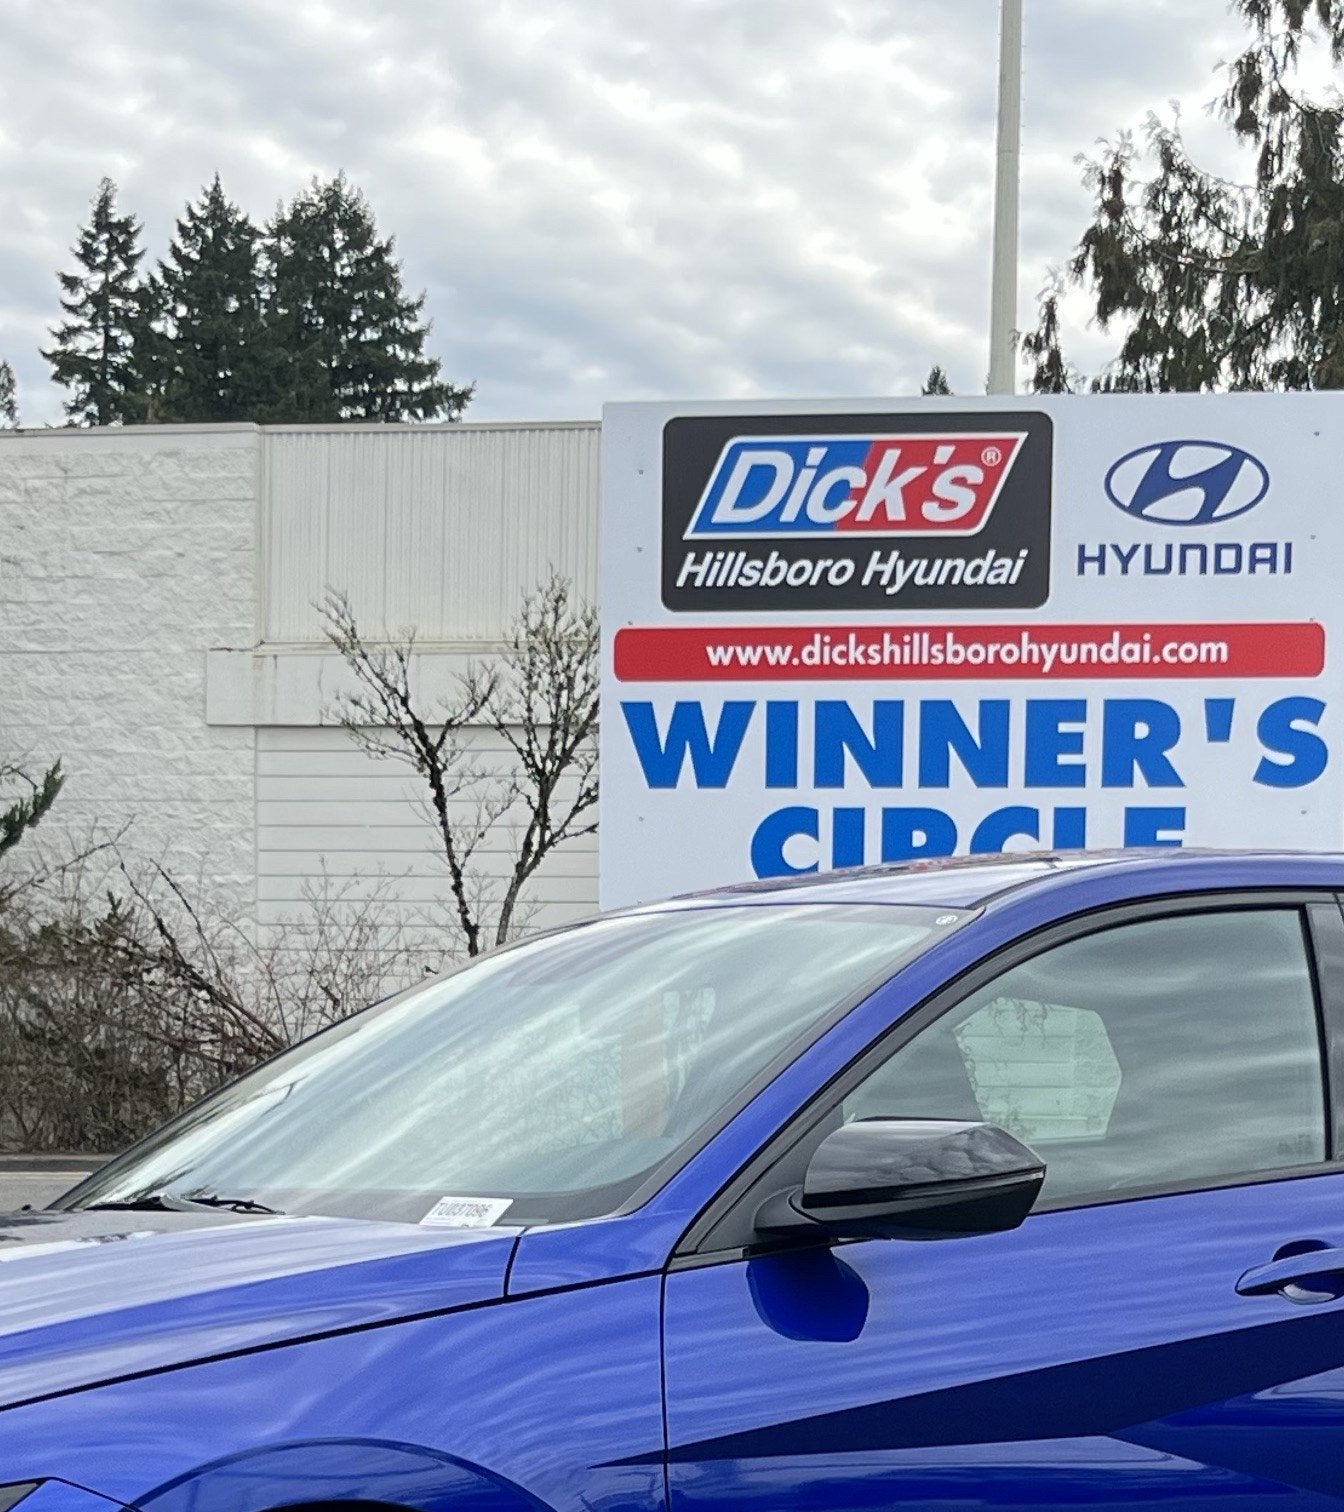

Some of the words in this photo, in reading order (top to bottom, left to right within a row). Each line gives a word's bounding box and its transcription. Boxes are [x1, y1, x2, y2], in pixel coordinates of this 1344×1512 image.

[712, 444, 983, 525] Dick's
[676, 550, 855, 588] Hillsboro
[861, 548, 1029, 596] Hyundai
[1077, 541, 1294, 577] HYUNDAI
[705, 631, 1229, 674] www.dickshillsborohyundai.com
[620, 695, 1330, 790] WINNER'S
